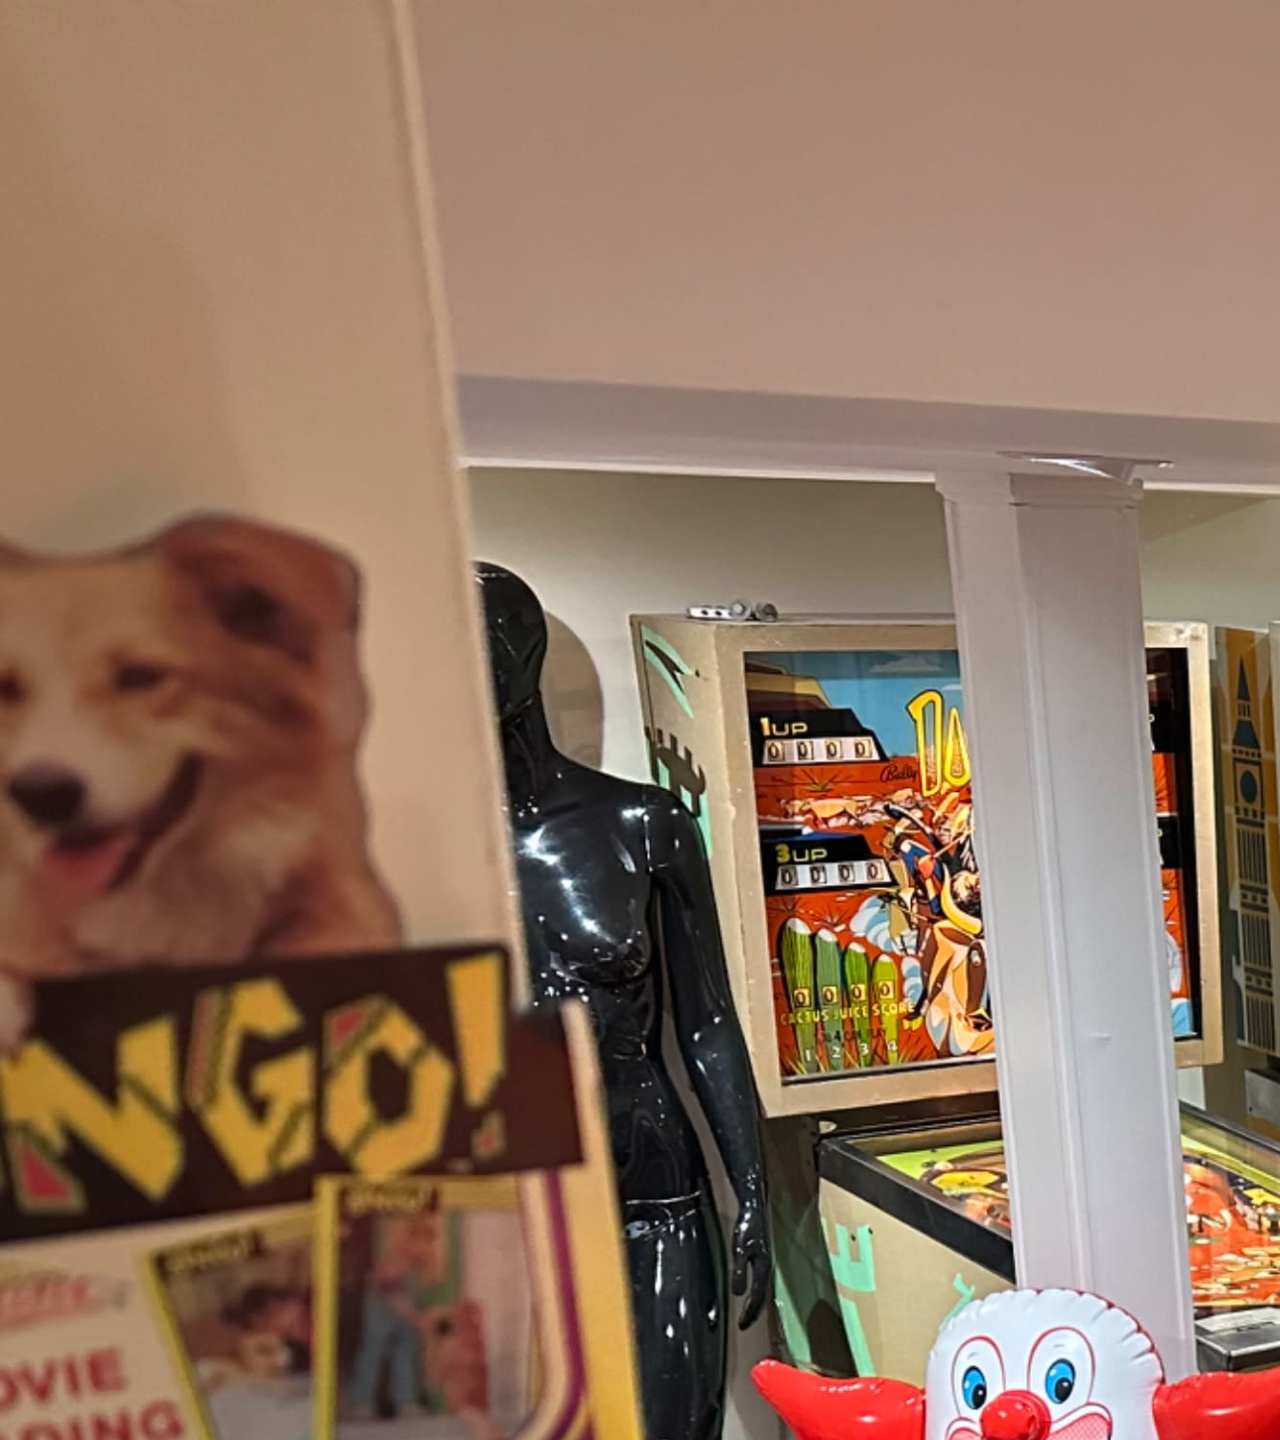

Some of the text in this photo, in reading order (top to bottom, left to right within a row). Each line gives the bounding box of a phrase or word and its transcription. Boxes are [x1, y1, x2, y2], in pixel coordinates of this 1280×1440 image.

[780, 1000, 915, 1025] CACTUS JUICE SCORE
